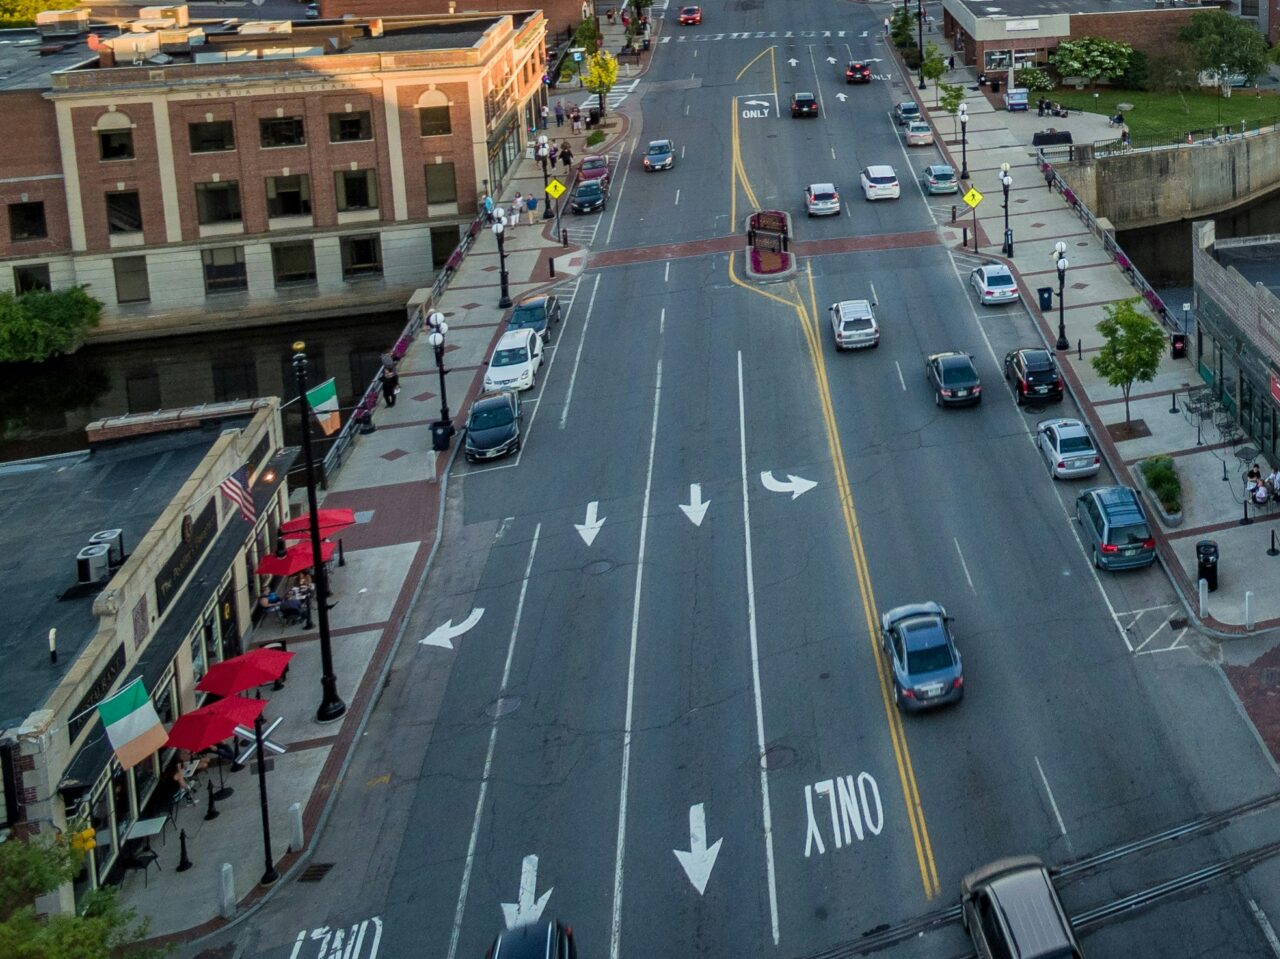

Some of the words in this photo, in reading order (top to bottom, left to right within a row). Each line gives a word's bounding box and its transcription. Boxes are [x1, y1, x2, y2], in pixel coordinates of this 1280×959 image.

[197, 89, 252, 98] NASHUA
[742, 108, 769, 118] ONLY
[805, 771, 884, 857] ONLY
